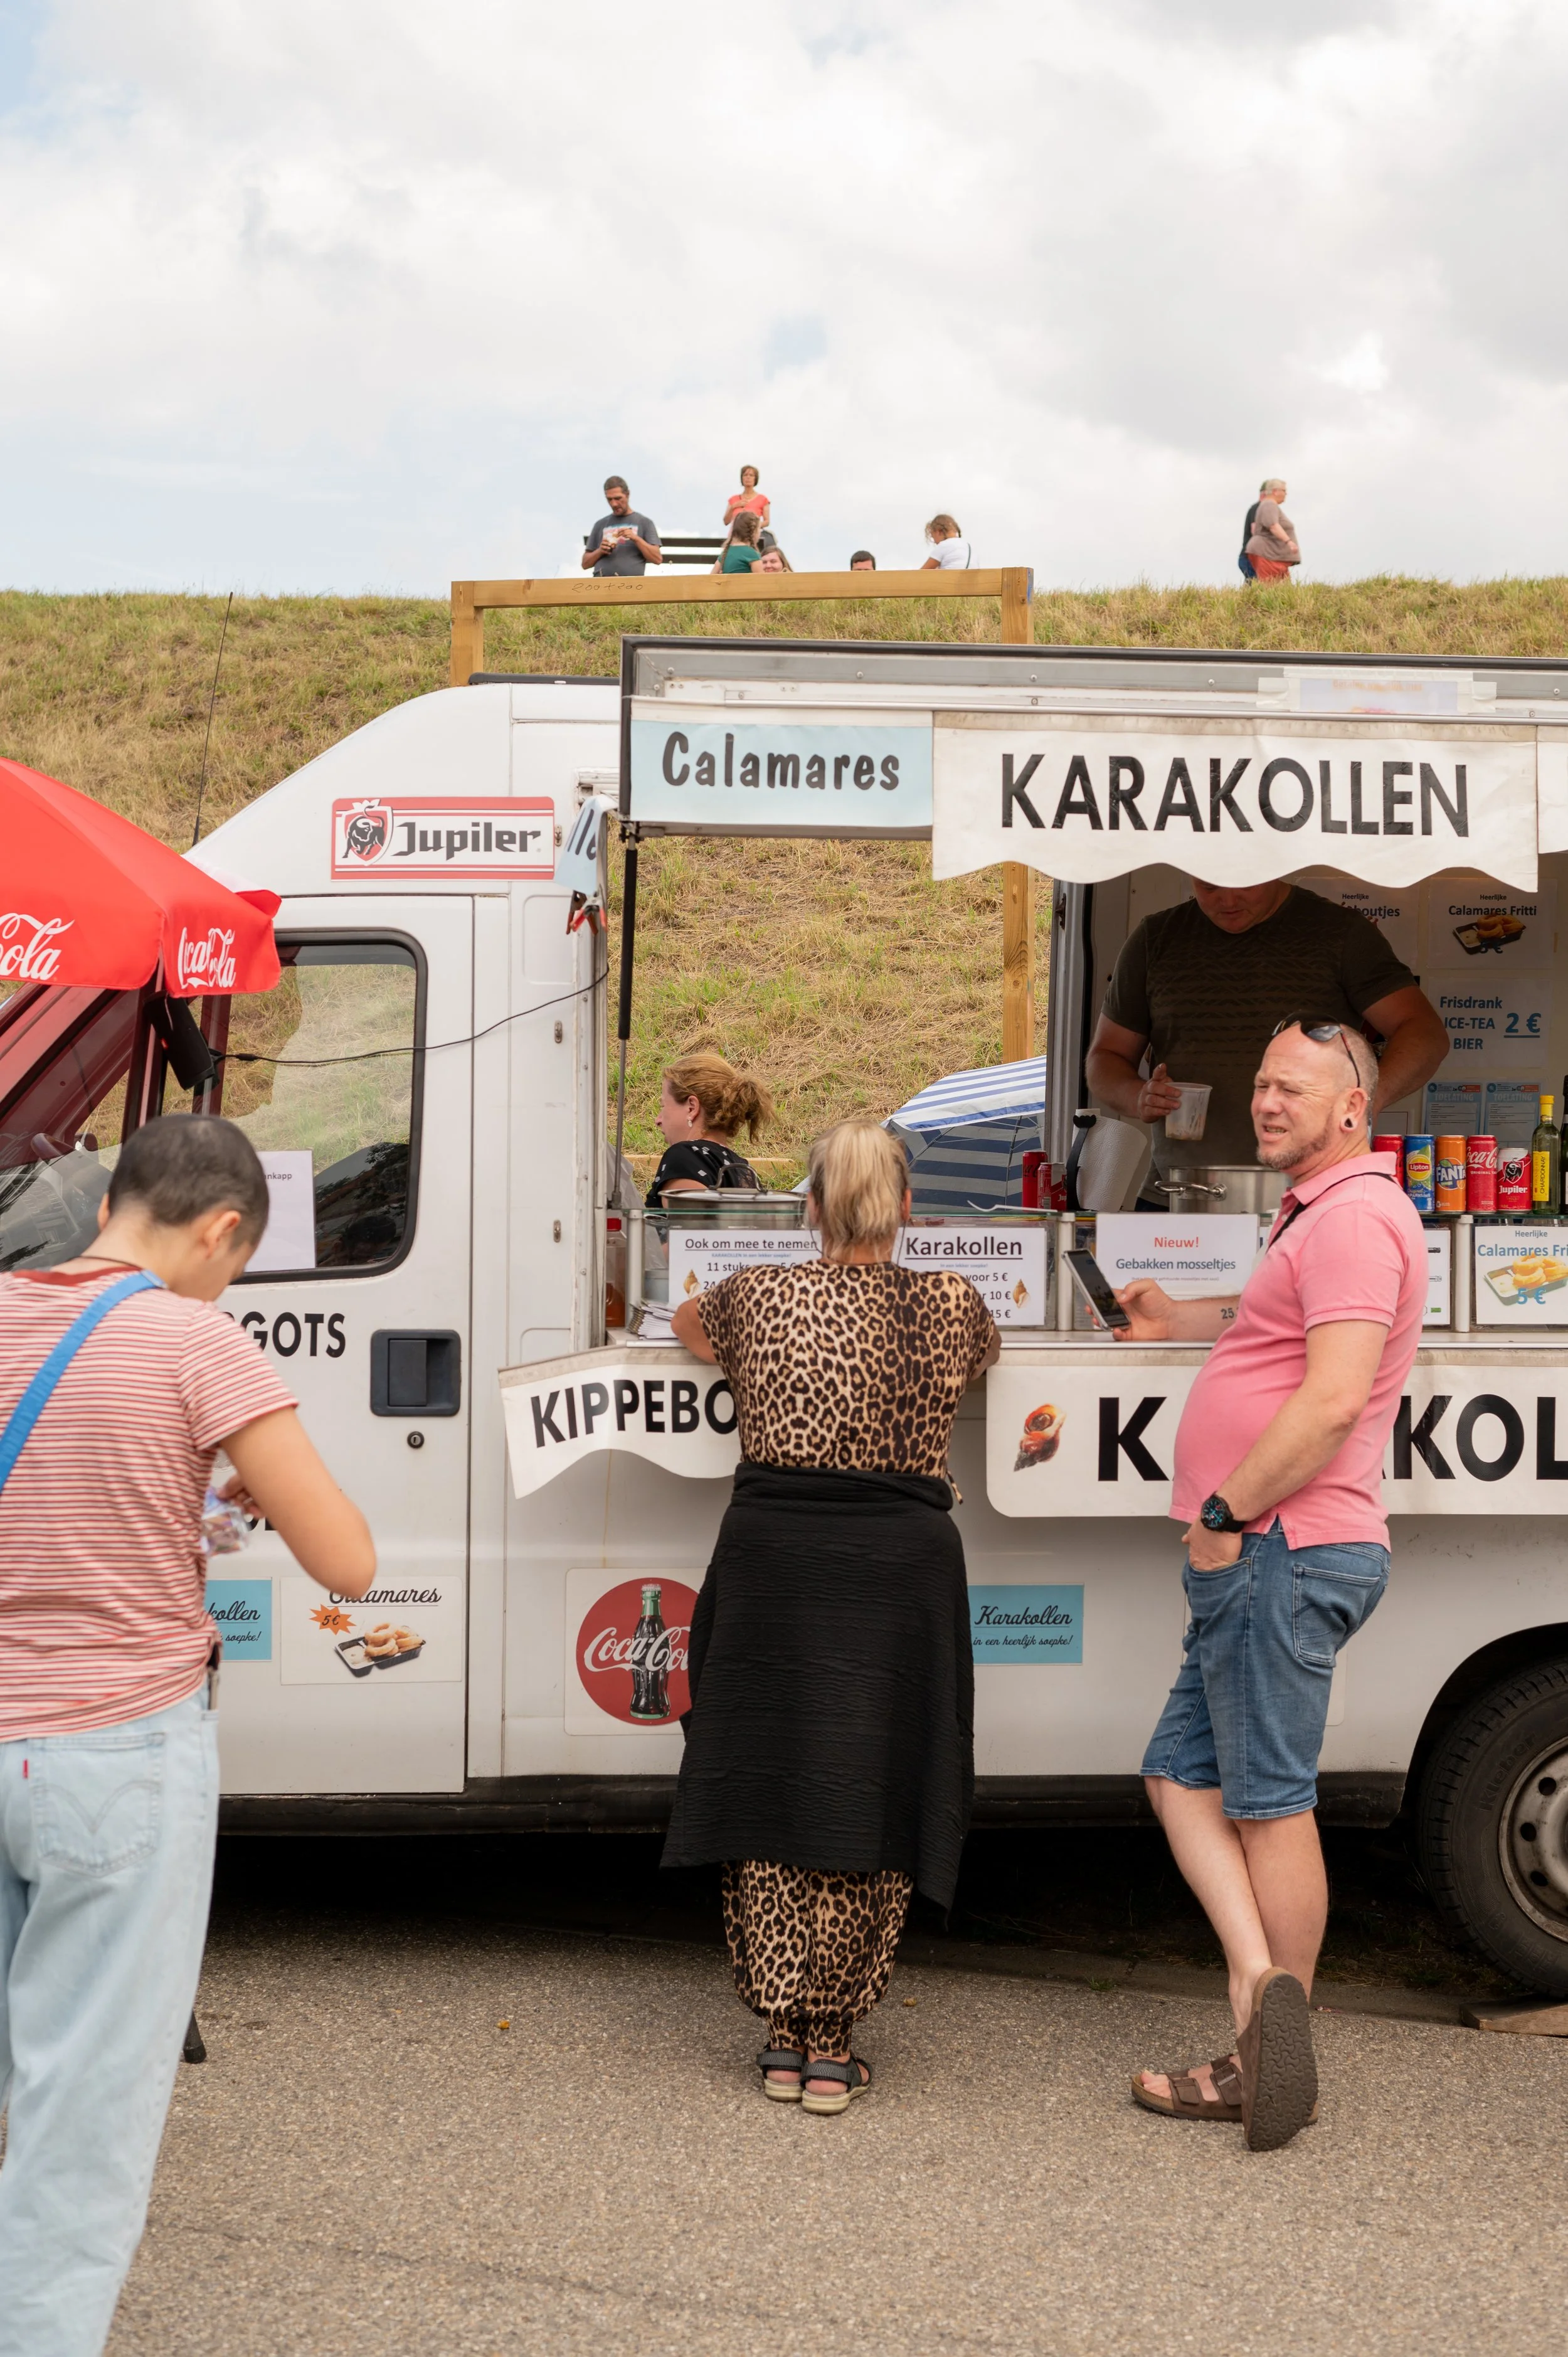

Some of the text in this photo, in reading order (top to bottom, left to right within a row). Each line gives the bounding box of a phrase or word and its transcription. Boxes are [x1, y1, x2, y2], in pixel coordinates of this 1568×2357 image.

[662, 732, 899, 791] Calamares
[1002, 753, 1469, 838] KARAKOLLEN
[390, 821, 541, 861] Jupiler
[1448, 905, 1537, 916] Calamares Fritti
[1439, 996, 1503, 1009] Frisdrank
[1444, 1013, 1542, 1033] ICE-TEA 2 €
[1453, 1038, 1483, 1050] BIER
[1436, 1165, 1466, 1181] FANTA
[1498, 1185, 1527, 1194] Jupiler
[1515, 1230, 1548, 1238] Heerlijke
[686, 1238, 709, 1248] Ook
[712, 1240, 730, 1248] om
[734, 1240, 759, 1248] mee
[763, 1240, 774, 1248] te
[906, 1236, 1022, 1255] Karakollen
[1154, 1237, 1199, 1248] Nieuw!
[1478, 1244, 1549, 1257] Calamares
[707, 1262, 719, 1271] 11
[1116, 1258, 1236, 1272] Gebakken mosseltjes
[993, 1272, 999, 1281] 5
[1002, 1272, 1009, 1281] €
[990, 1291, 1002, 1300] 10
[1005, 1291, 1011, 1300] €
[1517, 1287, 1546, 1304] 5 €
[1005, 1310, 1011, 1318] €
[225, 1311, 346, 1358] GOTS
[531, 1379, 738, 1448] KIPPEBO
[208, 1600, 261, 1620] kollen
[974, 1605, 1073, 1625] Karakollen
[226, 1631, 262, 1644] soepke!
[973, 1637, 982, 1645] in
[1002, 1634, 1037, 1649] heerlijk
[1039, 1634, 1073, 1647] soepke!
[1477, 1733, 1538, 1812] Kleber
